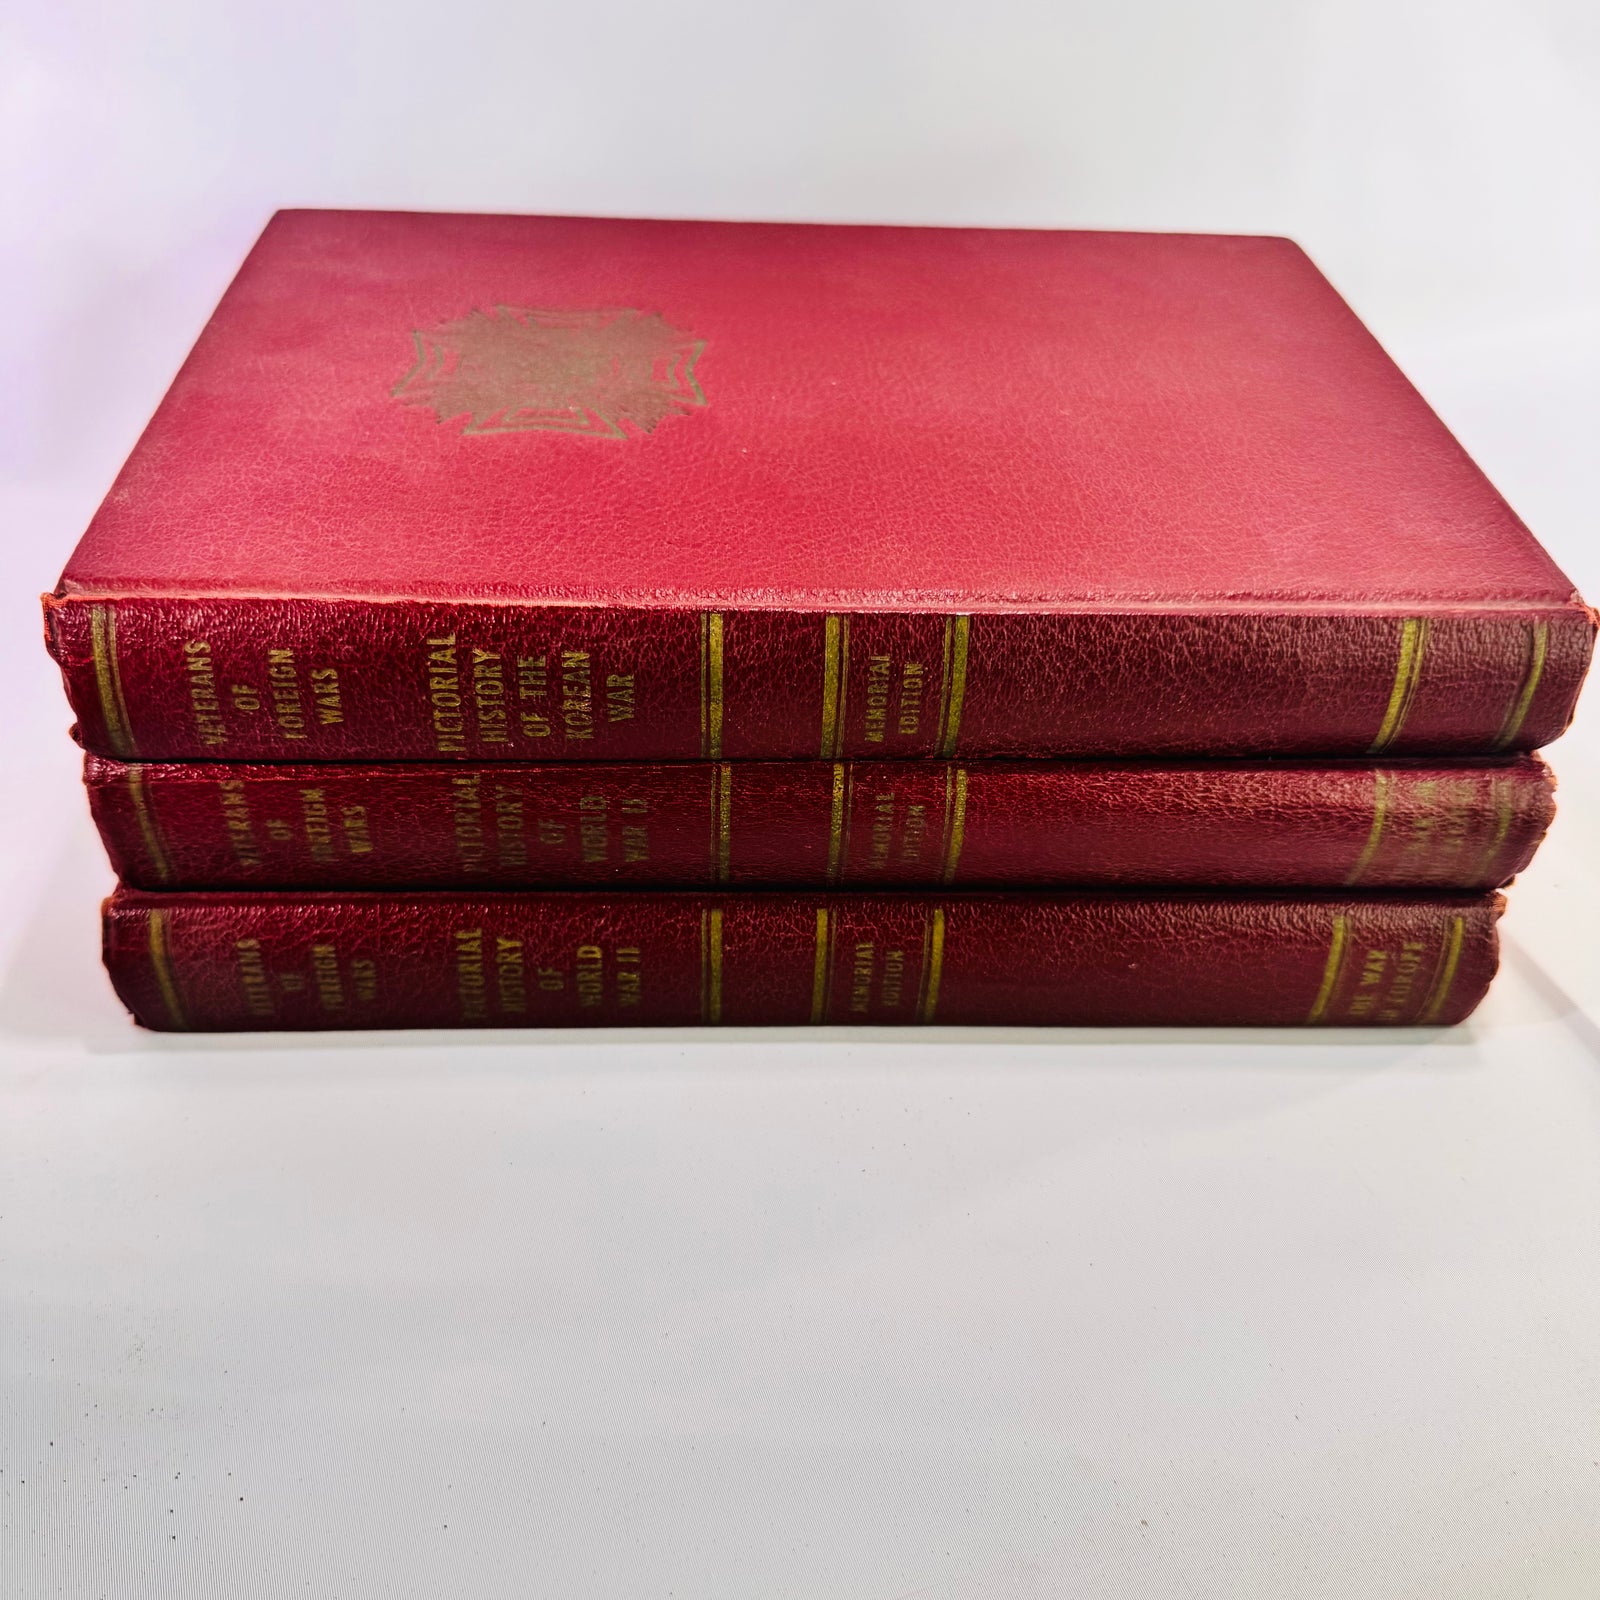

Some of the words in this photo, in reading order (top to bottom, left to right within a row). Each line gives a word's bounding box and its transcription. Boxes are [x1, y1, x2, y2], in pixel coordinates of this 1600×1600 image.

[231, 684, 260, 711] OF
[311, 668, 344, 725] WARS
[426, 631, 466, 752] PICTORIAL
[472, 648, 509, 743] HISTORY
[517, 655, 547, 700] THE
[561, 650, 594, 739] KOREAN
[606, 673, 635, 723] WAR
[864, 653, 891, 742] MEMORIAL
[899, 661, 924, 734] EDITION
[520, 711, 551, 737] OF
[497, 938, 526, 1013] HISTORY
[537, 967, 564, 990] OF
[577, 946, 602, 1007] WORLD
[617, 948, 640, 963] II
